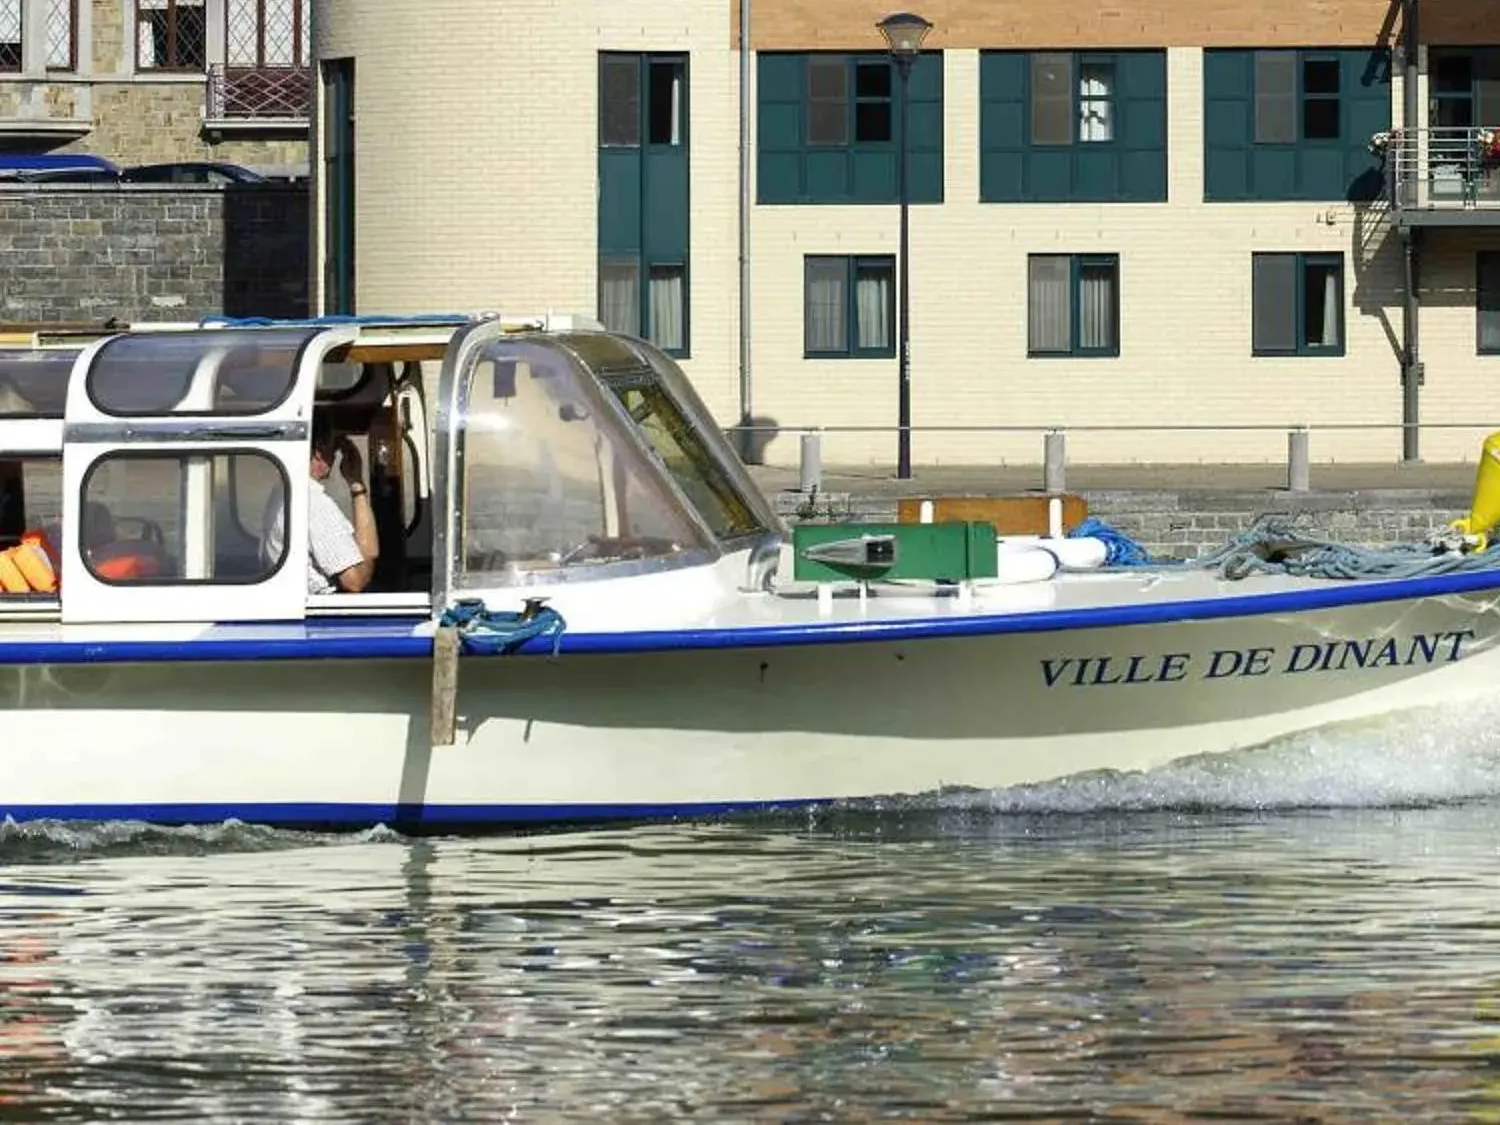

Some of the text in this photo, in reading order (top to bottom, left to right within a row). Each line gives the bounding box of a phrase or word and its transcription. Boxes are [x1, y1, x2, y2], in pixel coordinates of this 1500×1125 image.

[1039, 630, 1475, 687] VILLE DE DINANT
